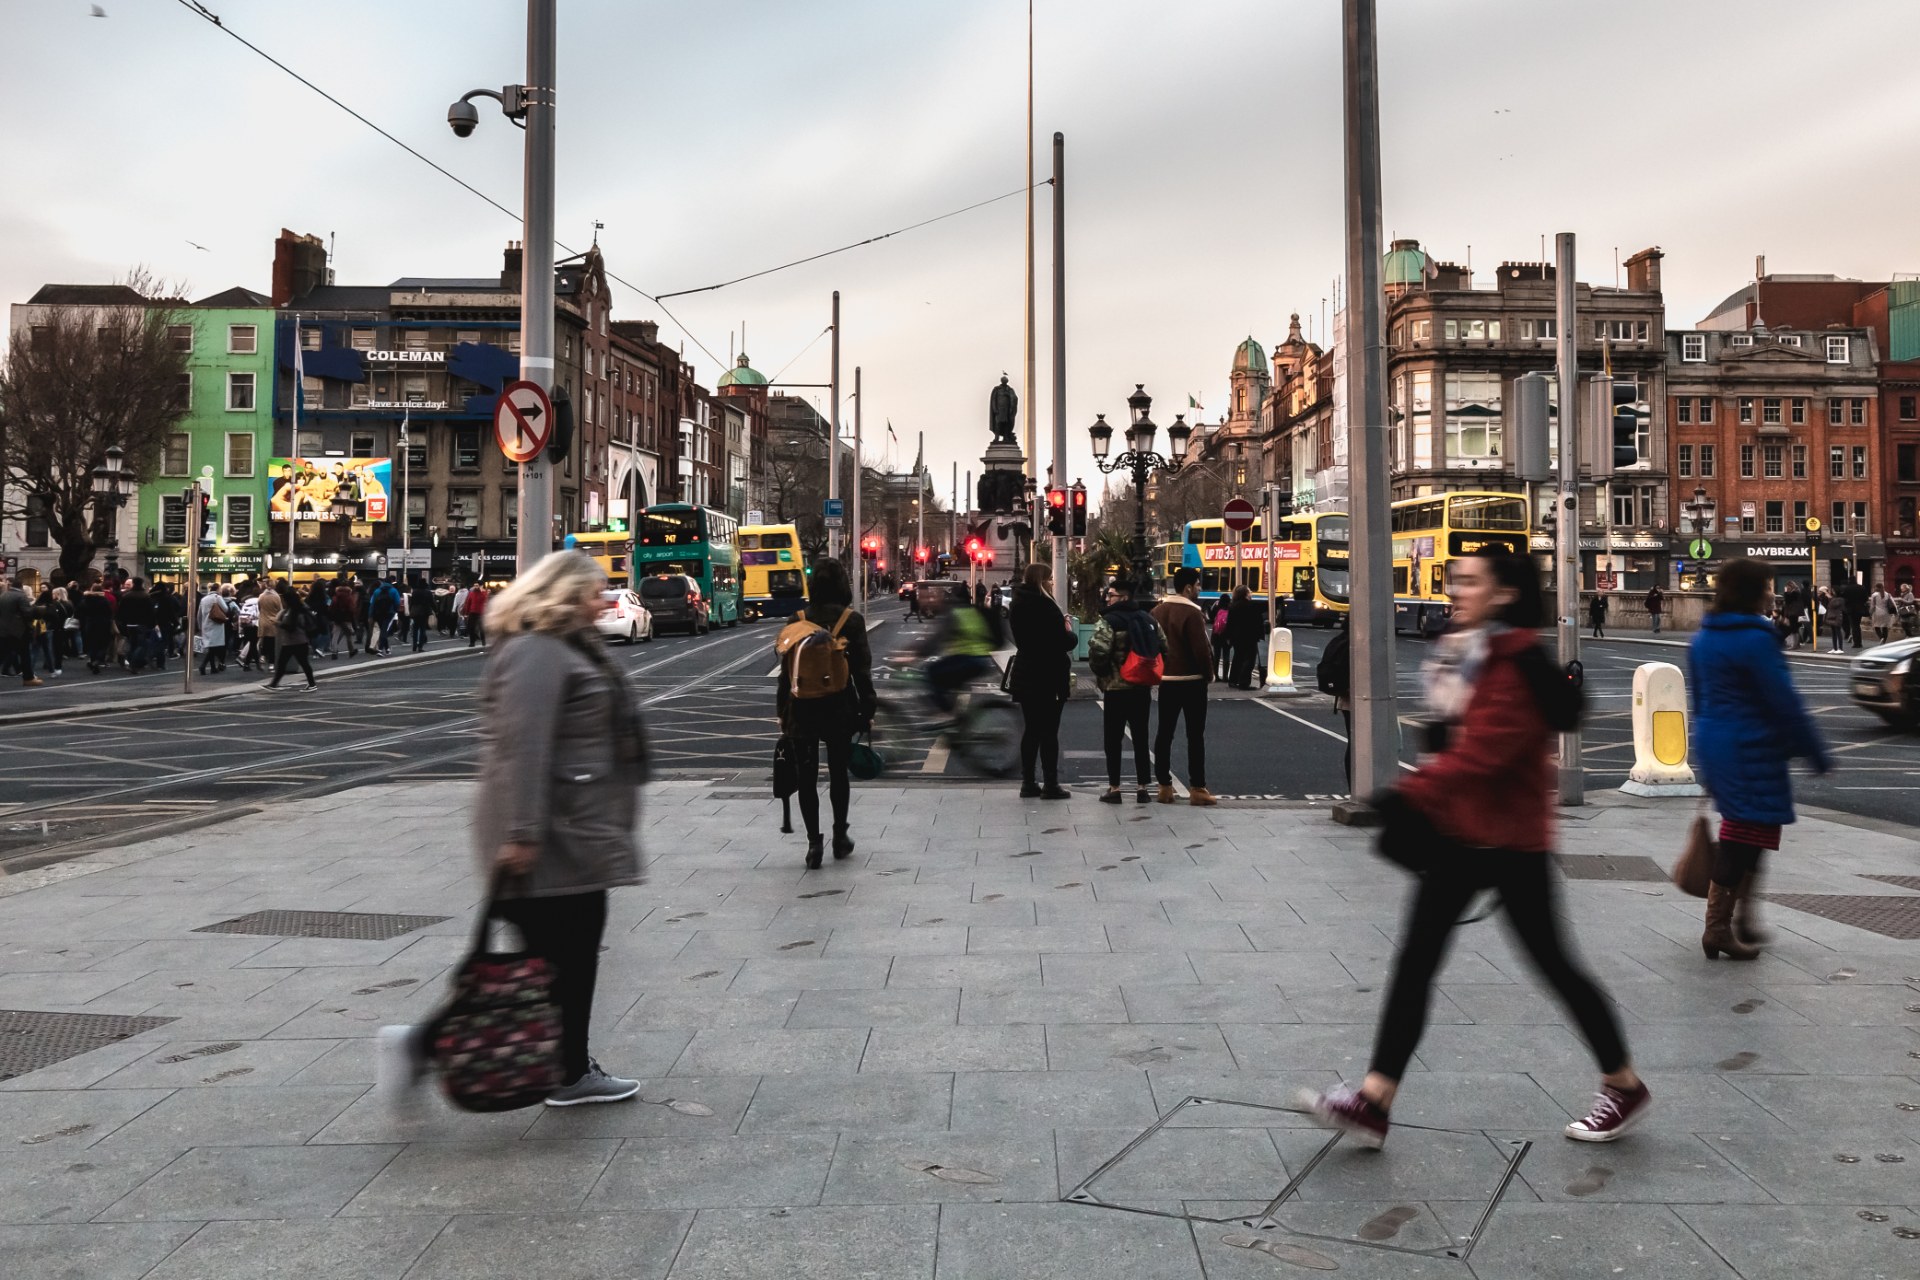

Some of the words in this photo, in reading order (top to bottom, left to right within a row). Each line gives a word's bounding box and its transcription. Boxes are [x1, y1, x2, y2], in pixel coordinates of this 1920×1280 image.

[366, 351, 445, 362] COLEMAN
[368, 400, 392, 408] Have
[402, 400, 423, 408] nice
[427, 400, 446, 411] day!
[270, 511, 283, 520] THE
[284, 511, 302, 520] FOD
[664, 534, 677, 543] 747
[1578, 539, 1601, 548] ANGE
[1205, 548, 1215, 560] UP
[1215, 548, 1224, 560] TO
[1241, 546, 1254, 559] ACK
[1262, 546, 1284, 559] CSH
[1747, 547, 1810, 557] DAYBREAK
